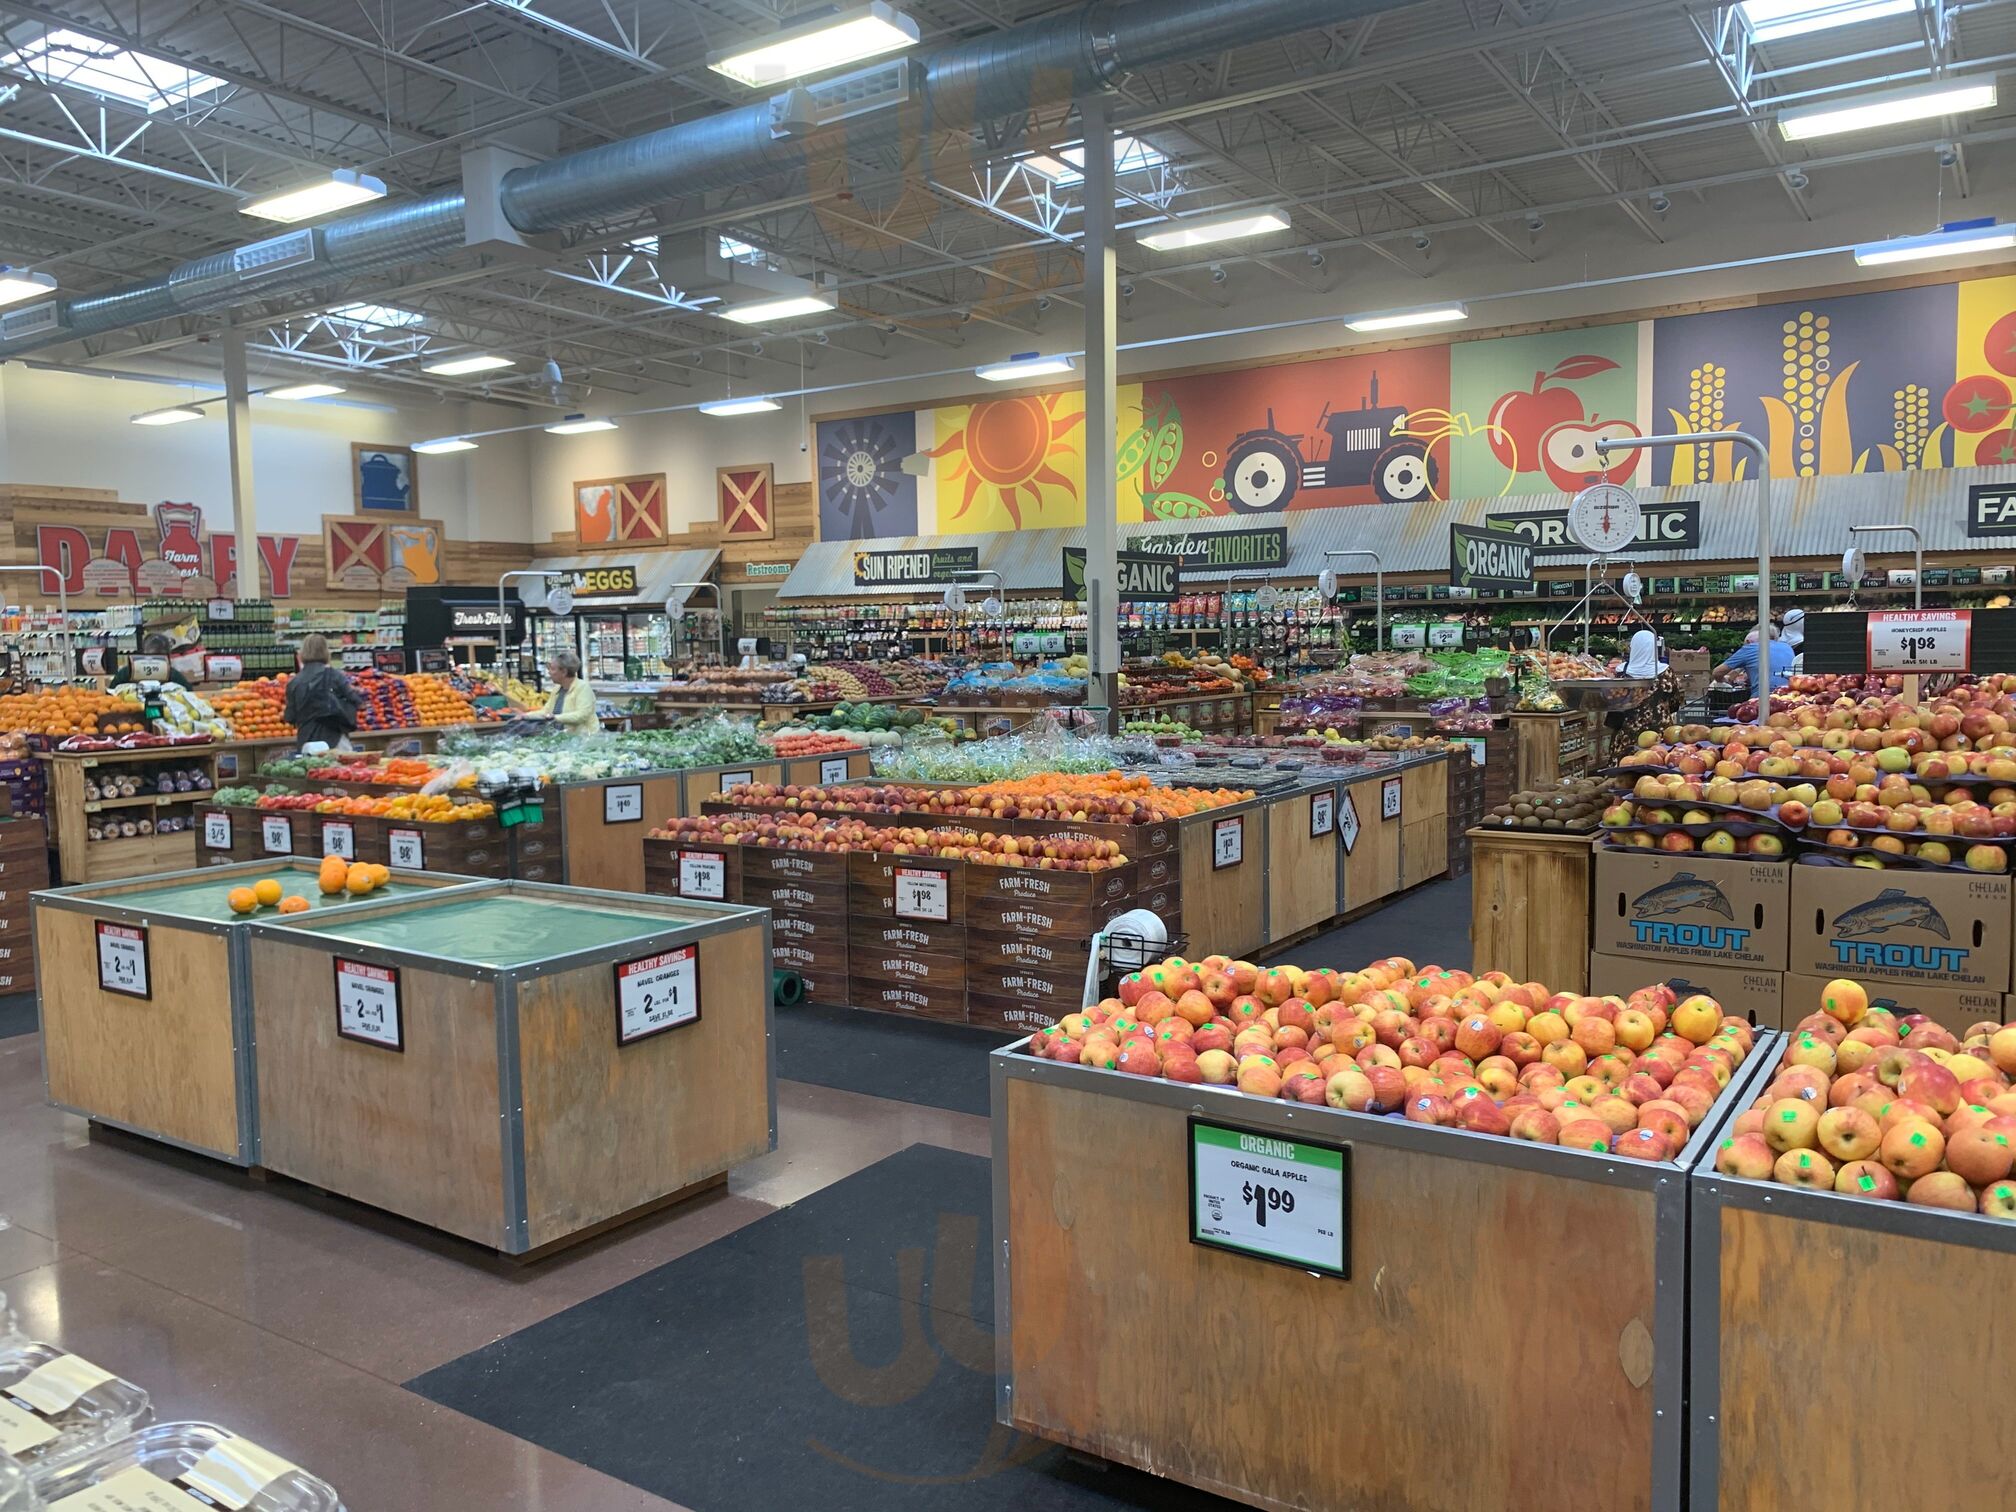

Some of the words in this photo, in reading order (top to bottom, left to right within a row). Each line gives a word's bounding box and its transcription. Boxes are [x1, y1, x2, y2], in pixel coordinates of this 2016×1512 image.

[165, 549, 199, 564] Farm
[1207, 533, 1281, 565] FAVORITES
[863, 555, 887, 581] SUN
[887, 553, 930, 579] RIPENED
[1465, 539, 1531, 580] ORGANIC
[746, 563, 791, 576] Restrooms
[1117, 562, 1175, 593] GANIC
[585, 569, 634, 592] EGGS
[454, 612, 484, 626] Fresh
[1882, 613, 1919, 622] HEALTHY
[1921, 612, 1957, 621] SAVINGS
[772, 858, 814, 872] FARM-FRESH
[1750, 866, 1784, 878] CHELAN
[999, 877, 1050, 894] FARM-FRESH
[1013, 889, 1037, 898] Produce
[1968, 882, 2008, 894] CHELAN
[772, 889, 815, 904] FARM-FRESH
[772, 919, 815, 934] FARM-FRESH
[1001, 912, 1053, 928] FARM-FRESH
[882, 929, 930, 945] FARM-FRESH
[1016, 924, 1038, 934] Produce
[1629, 919, 1751, 952] TROUT
[896, 940, 916, 950] Produce
[1001, 944, 1053, 960] FARM-FRESH
[1616, 942, 1662, 952] WASHINGTON
[1663, 946, 1689, 955] APPLES
[1691, 949, 1712, 957] FROM
[1714, 951, 1733, 960] LAKE
[1734, 953, 1764, 962] CHELAN
[628, 957, 659, 974] HEALTHY
[659, 949, 687, 966] SAVINGS
[772, 948, 814, 962] FARM-FRESH
[1016, 955, 1039, 965] Produce
[1830, 939, 1970, 974] TROUT
[114, 956, 120, 973] 2
[882, 960, 929, 976] FARM-FRESH
[637, 977, 654, 988] NAVEL
[656, 969, 680, 982] ORANGES
[896, 971, 916, 980] Produce
[1815, 962, 1868, 974] WASHINGTON
[1869, 966, 1899, 977] APPLES
[1901, 969, 1925, 979] FROM
[1928, 972, 1950, 981] LAKE
[1952, 974, 1986, 984] CHELAN
[1002, 976, 1054, 994] FARM-FRESH
[1743, 976, 1776, 988] CHELAN
[644, 994, 653, 1014] 2
[668, 986, 678, 1005] $1
[882, 990, 929, 1006] FARM-FRESH
[1016, 988, 1040, 998] Produce
[1959, 994, 1997, 1008] CHELAN
[357, 998, 365, 1018] 2
[896, 1002, 916, 1010] Produce
[1004, 1010, 1055, 1027] FARM-FRESH
[1240, 1134, 1295, 1160] ORGANIC
[1230, 1160, 1260, 1173] ORGANIC
[1262, 1166, 1280, 1177] GALA
[1282, 1170, 1308, 1183] APPLES
[1242, 1181, 1295, 1228] $199
